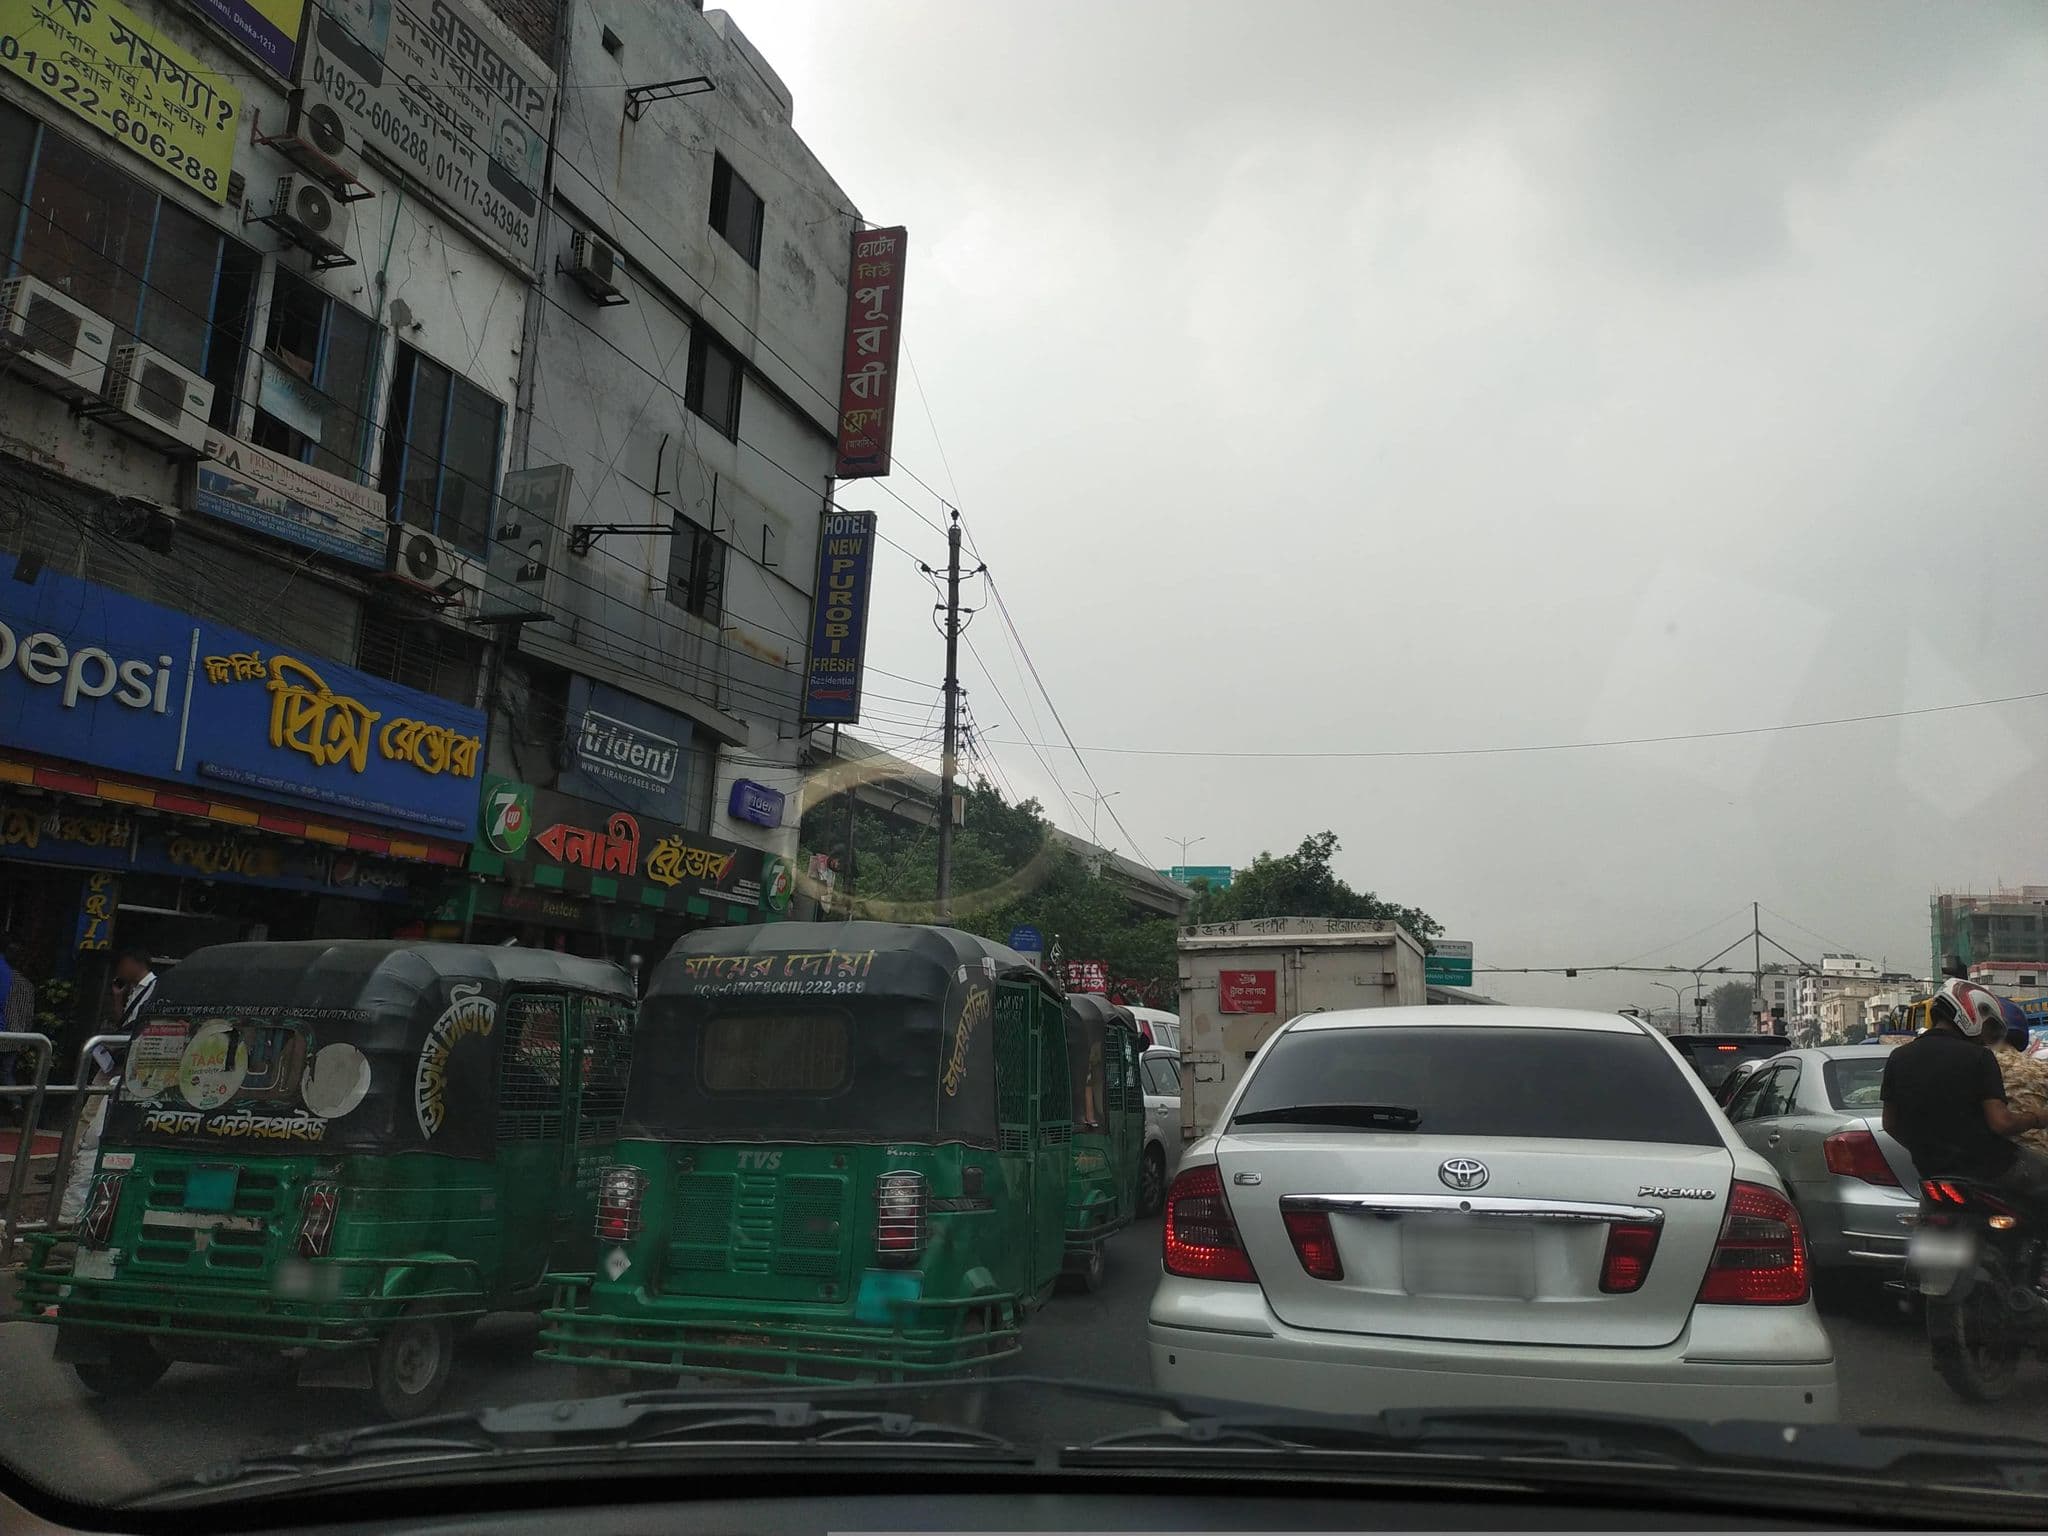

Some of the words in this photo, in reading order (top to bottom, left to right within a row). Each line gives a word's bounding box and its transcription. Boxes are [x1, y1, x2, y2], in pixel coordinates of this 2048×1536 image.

[32, 5, 98, 62] সমাধান
[104, 56, 141, 92] মাত্র
[233, 13, 276, 54] Dhaka-1213
[108, 15, 233, 131] সমস্যা?
[395, 5, 492, 108] সমাধান
[61, 51, 113, 93] হেয়ার
[119, 87, 175, 133] ফ্যাশন
[404, 73, 477, 141] হেয়ার
[0, 35, 218, 192] 01922-606288
[396, 86, 478, 168] ফ্যাশন
[312, 55, 432, 175] 01922-606288,
[436, 154, 529, 248] 01717-343943
[856, 236, 896, 259] হোটেল
[857, 262, 892, 280] নিউ
[824, 515, 868, 535] HOTEL
[829, 538, 863, 556] NEW
[204, 656, 230, 685] দি
[230, 650, 268, 683] নিউ
[810, 675, 855, 686] Residential
[812, 657, 856, 673] FRESH
[584, 722, 672, 776] trident
[536, 811, 641, 877] বনানী
[685, 953, 778, 980] মায়ের
[785, 949, 878, 978] দোয়া
[736, 1151, 783, 1170] TVS
[1638, 1186, 1716, 1200] PREMIO
